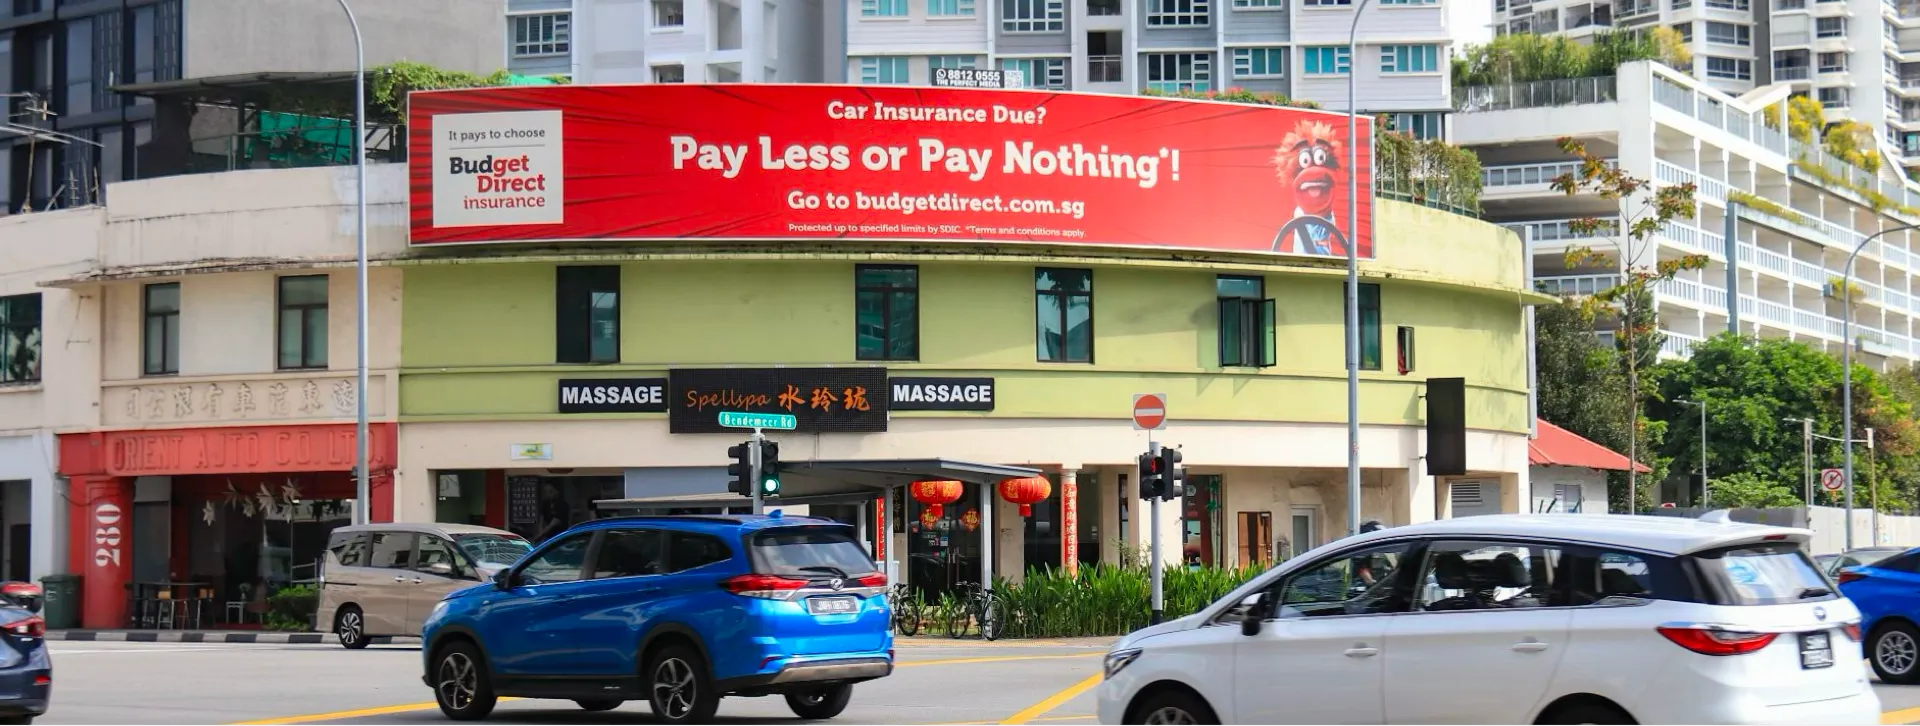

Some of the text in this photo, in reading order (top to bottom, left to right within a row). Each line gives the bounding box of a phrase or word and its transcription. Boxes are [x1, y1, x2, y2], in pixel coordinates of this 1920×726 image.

[947, 69, 1001, 81] 8812 0555
[828, 101, 1047, 125] Car Insurance Due?
[448, 128, 546, 143] It pays to choose
[449, 154, 530, 177] Budget
[670, 135, 748, 179] Pay
[758, 135, 850, 171] Less
[861, 145, 908, 172] or
[918, 138, 993, 182] Pay
[477, 173, 546, 193] Direct
[463, 195, 546, 210] insurance
[787, 190, 1086, 219] Go to budgetdirect.com.sg
[788, 223, 832, 233] Protected
[834, 225, 846, 235] up
[848, 225, 858, 233] to
[860, 224, 899, 235] specified
[901, 224, 926, 234] limits
[927, 225, 939, 235] by
[998, 227, 1015, 236] and
[1016, 226, 1061, 237] conditions
[1062, 228, 1087, 239] apply.
[562, 386, 663, 405] MASSAGE
[686, 389, 772, 411] Spellspa
[893, 384, 992, 403] MASSAGE
[724, 413, 793, 428] Bendemeer Rd
[113, 434, 184, 472] ORIENT
[95, 503, 121, 568] 280
